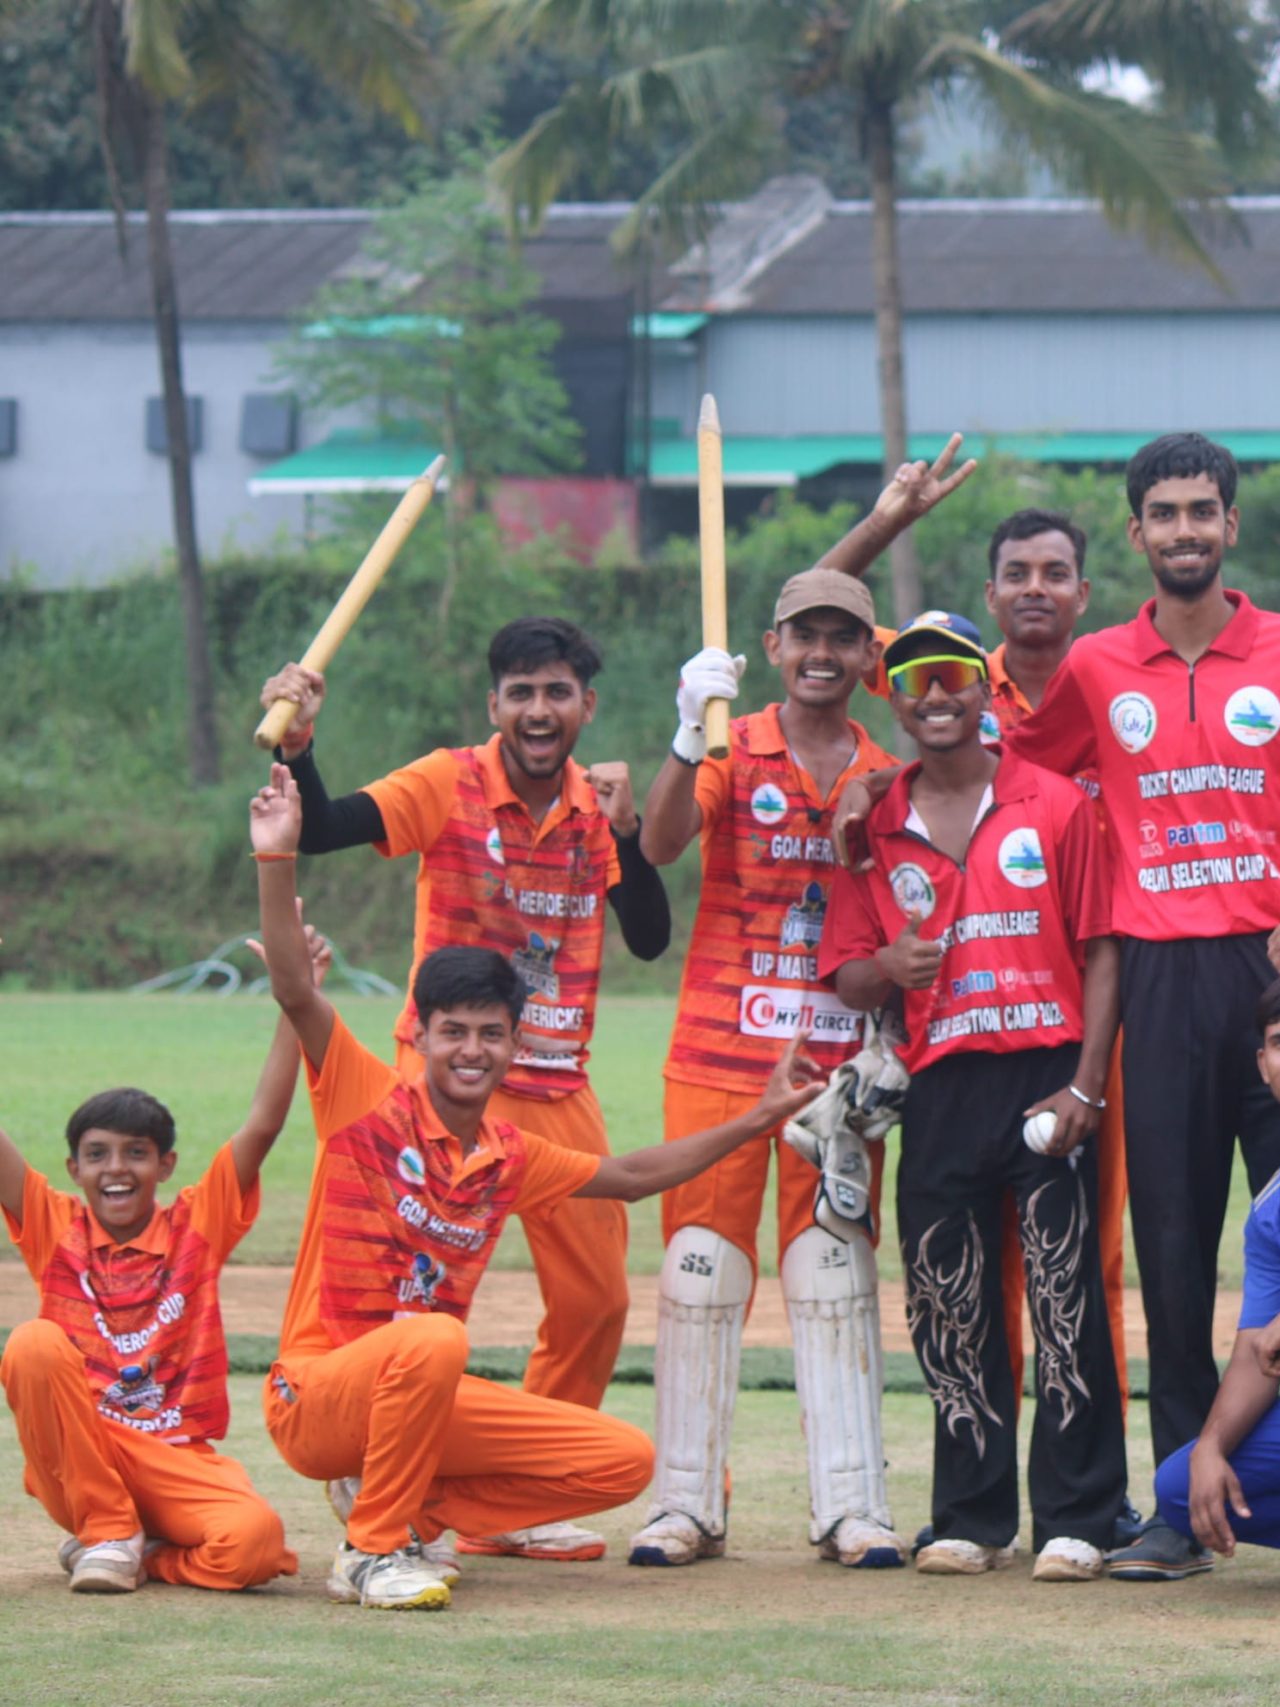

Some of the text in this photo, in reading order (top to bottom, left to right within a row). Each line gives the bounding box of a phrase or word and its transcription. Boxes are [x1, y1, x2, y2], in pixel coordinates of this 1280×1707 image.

[1228, 767, 1266, 795] EAGUE
[771, 834, 802, 859] GOA
[1171, 857, 1234, 890] SELECTION
[1235, 854, 1266, 882] CAMP
[752, 952, 775, 977] UP
[520, 1003, 584, 1032] VERICKS
[775, 1005, 854, 1031] MY11CIRCL
[1003, 1002, 1039, 1031] CAMP
[157, 1292, 186, 1325] CUP
